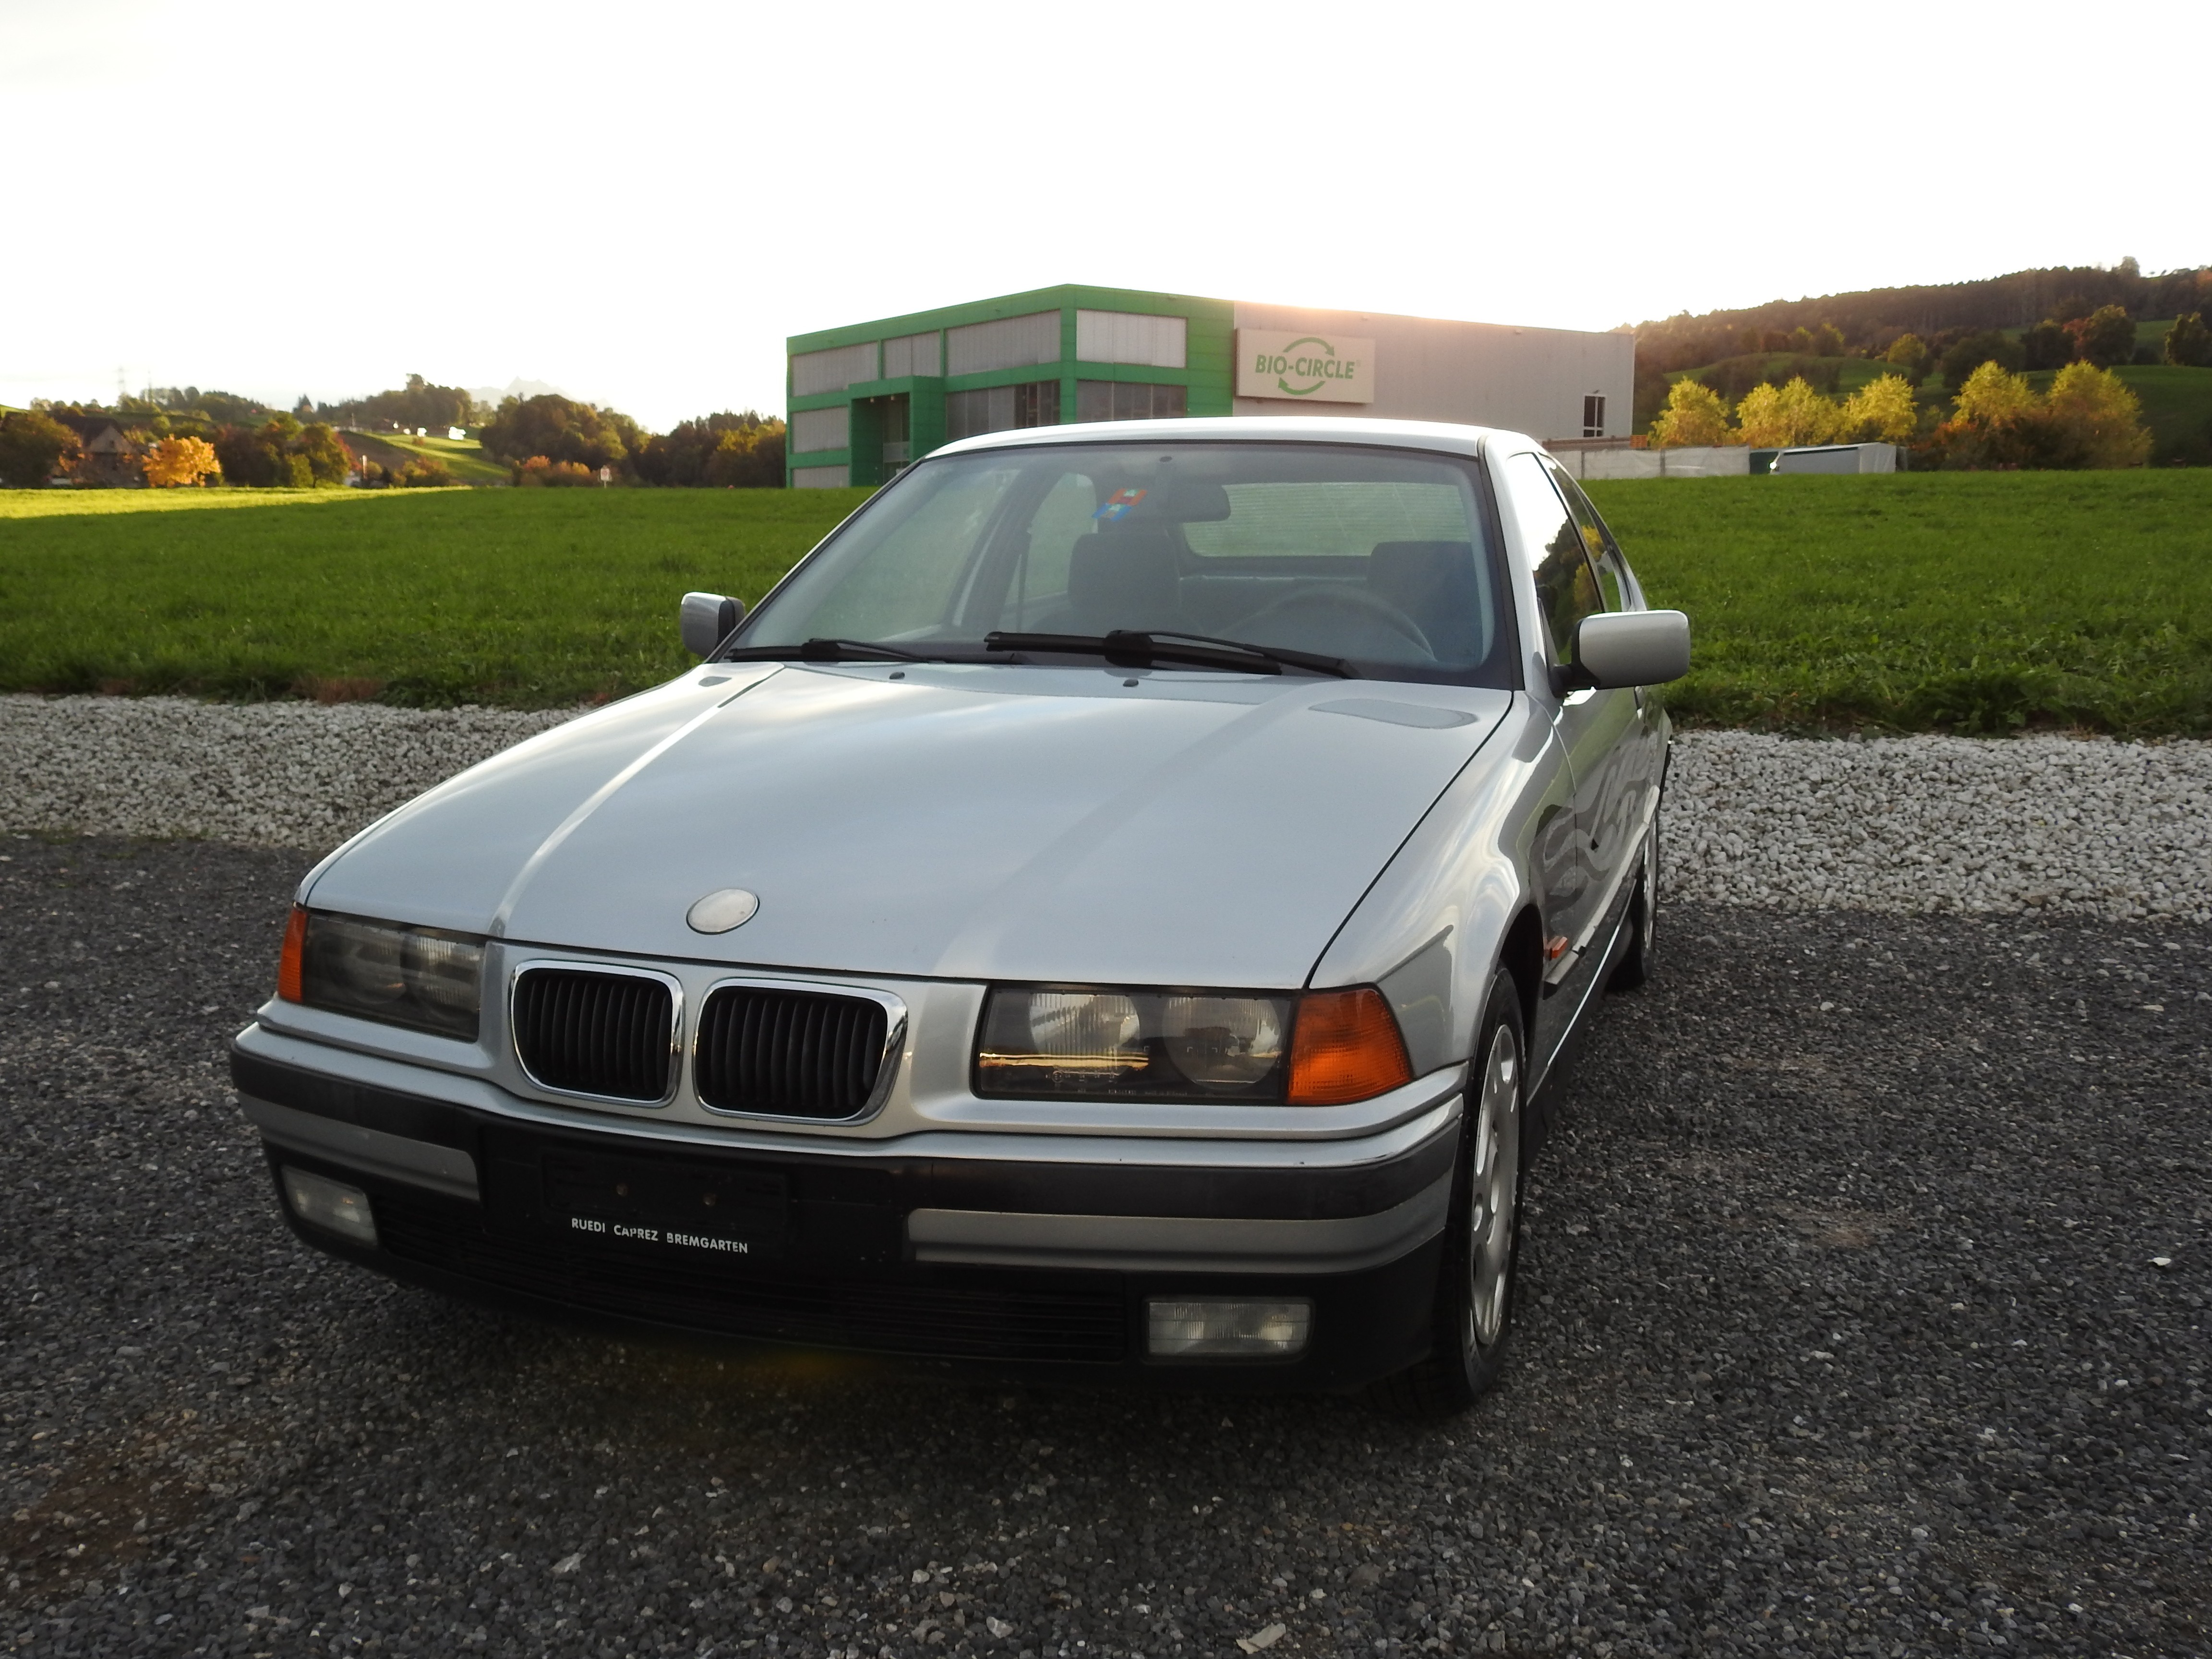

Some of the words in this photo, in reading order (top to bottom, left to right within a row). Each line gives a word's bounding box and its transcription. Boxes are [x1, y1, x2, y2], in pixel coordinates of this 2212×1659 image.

[1255, 354, 1355, 379] BIO-CIRCLE
[571, 1217, 606, 1233] RUEDI
[613, 1224, 659, 1242] CAPREZ
[666, 1232, 748, 1254] BREMGARTEN
